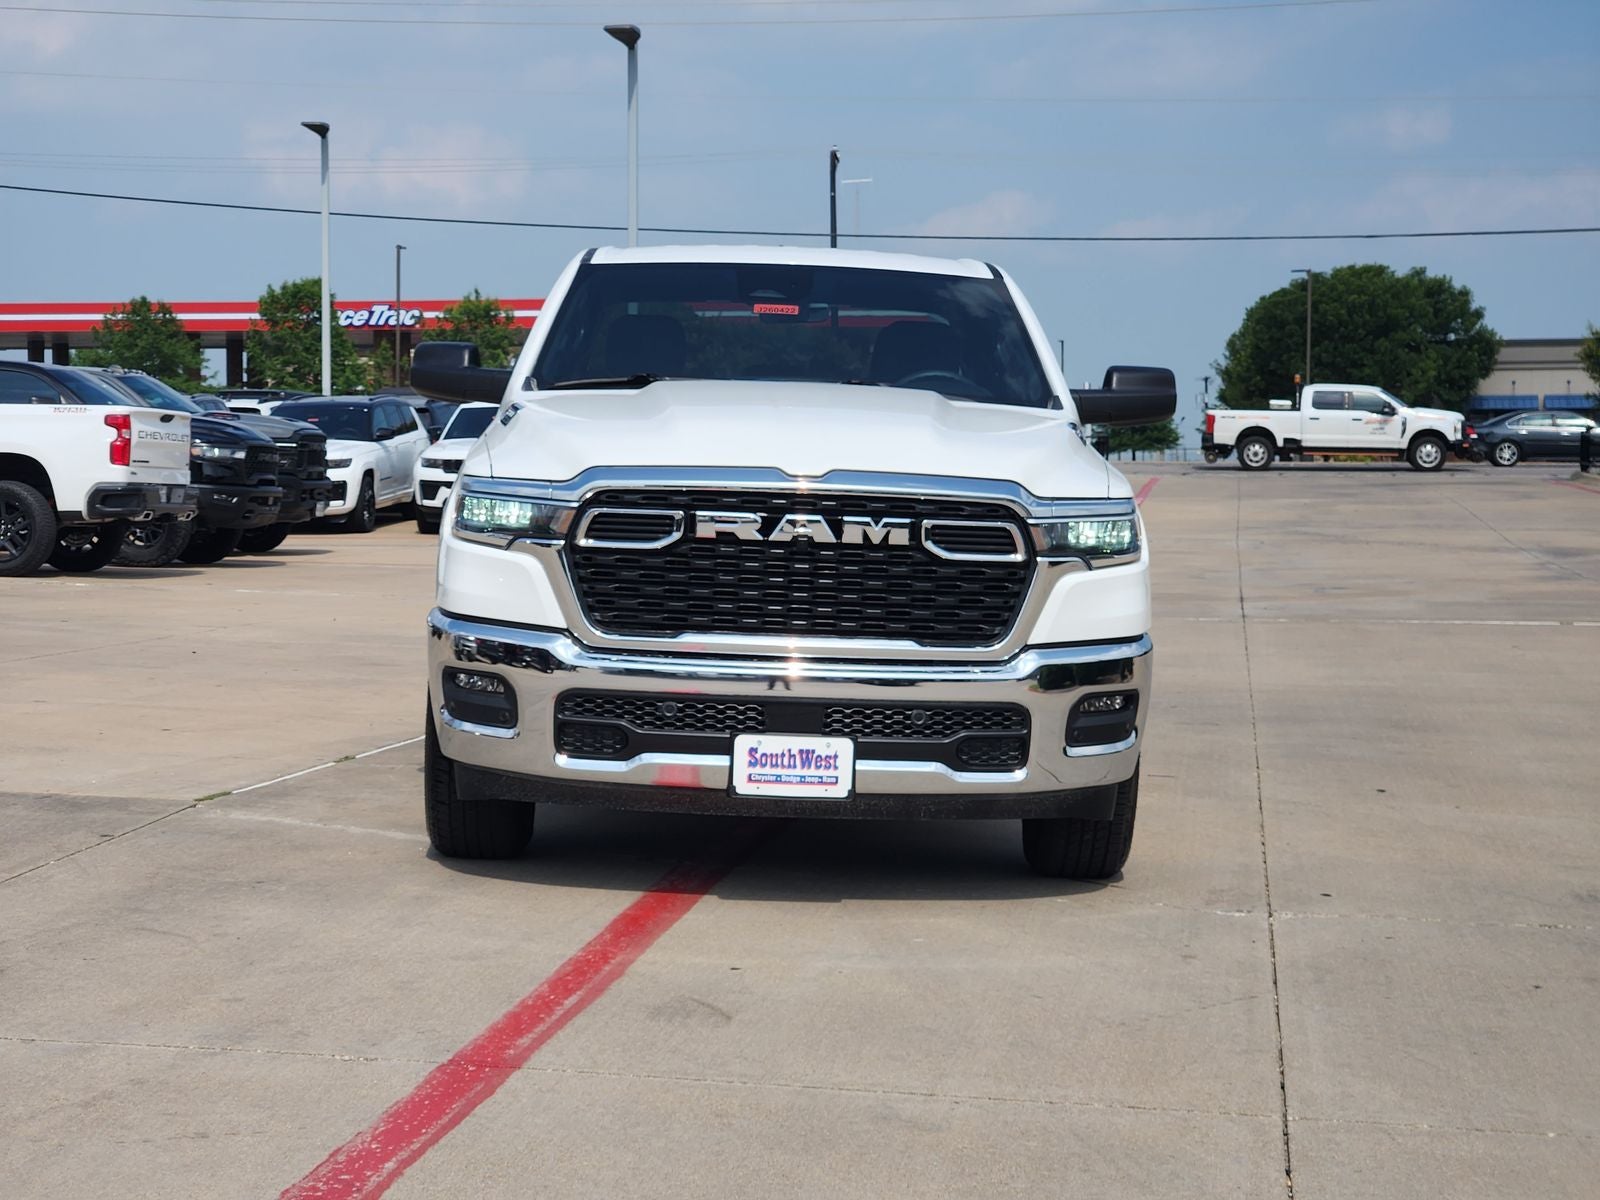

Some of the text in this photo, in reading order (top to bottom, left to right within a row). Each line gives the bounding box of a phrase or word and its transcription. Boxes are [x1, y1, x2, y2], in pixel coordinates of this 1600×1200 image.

[337, 304, 421, 326] ceTrac
[137, 430, 189, 442] CHEVROLET
[695, 510, 912, 545] RAM
[747, 747, 839, 770] SouthWest
[750, 773, 837, 784] Chrysler Dodge Jeep Ram
